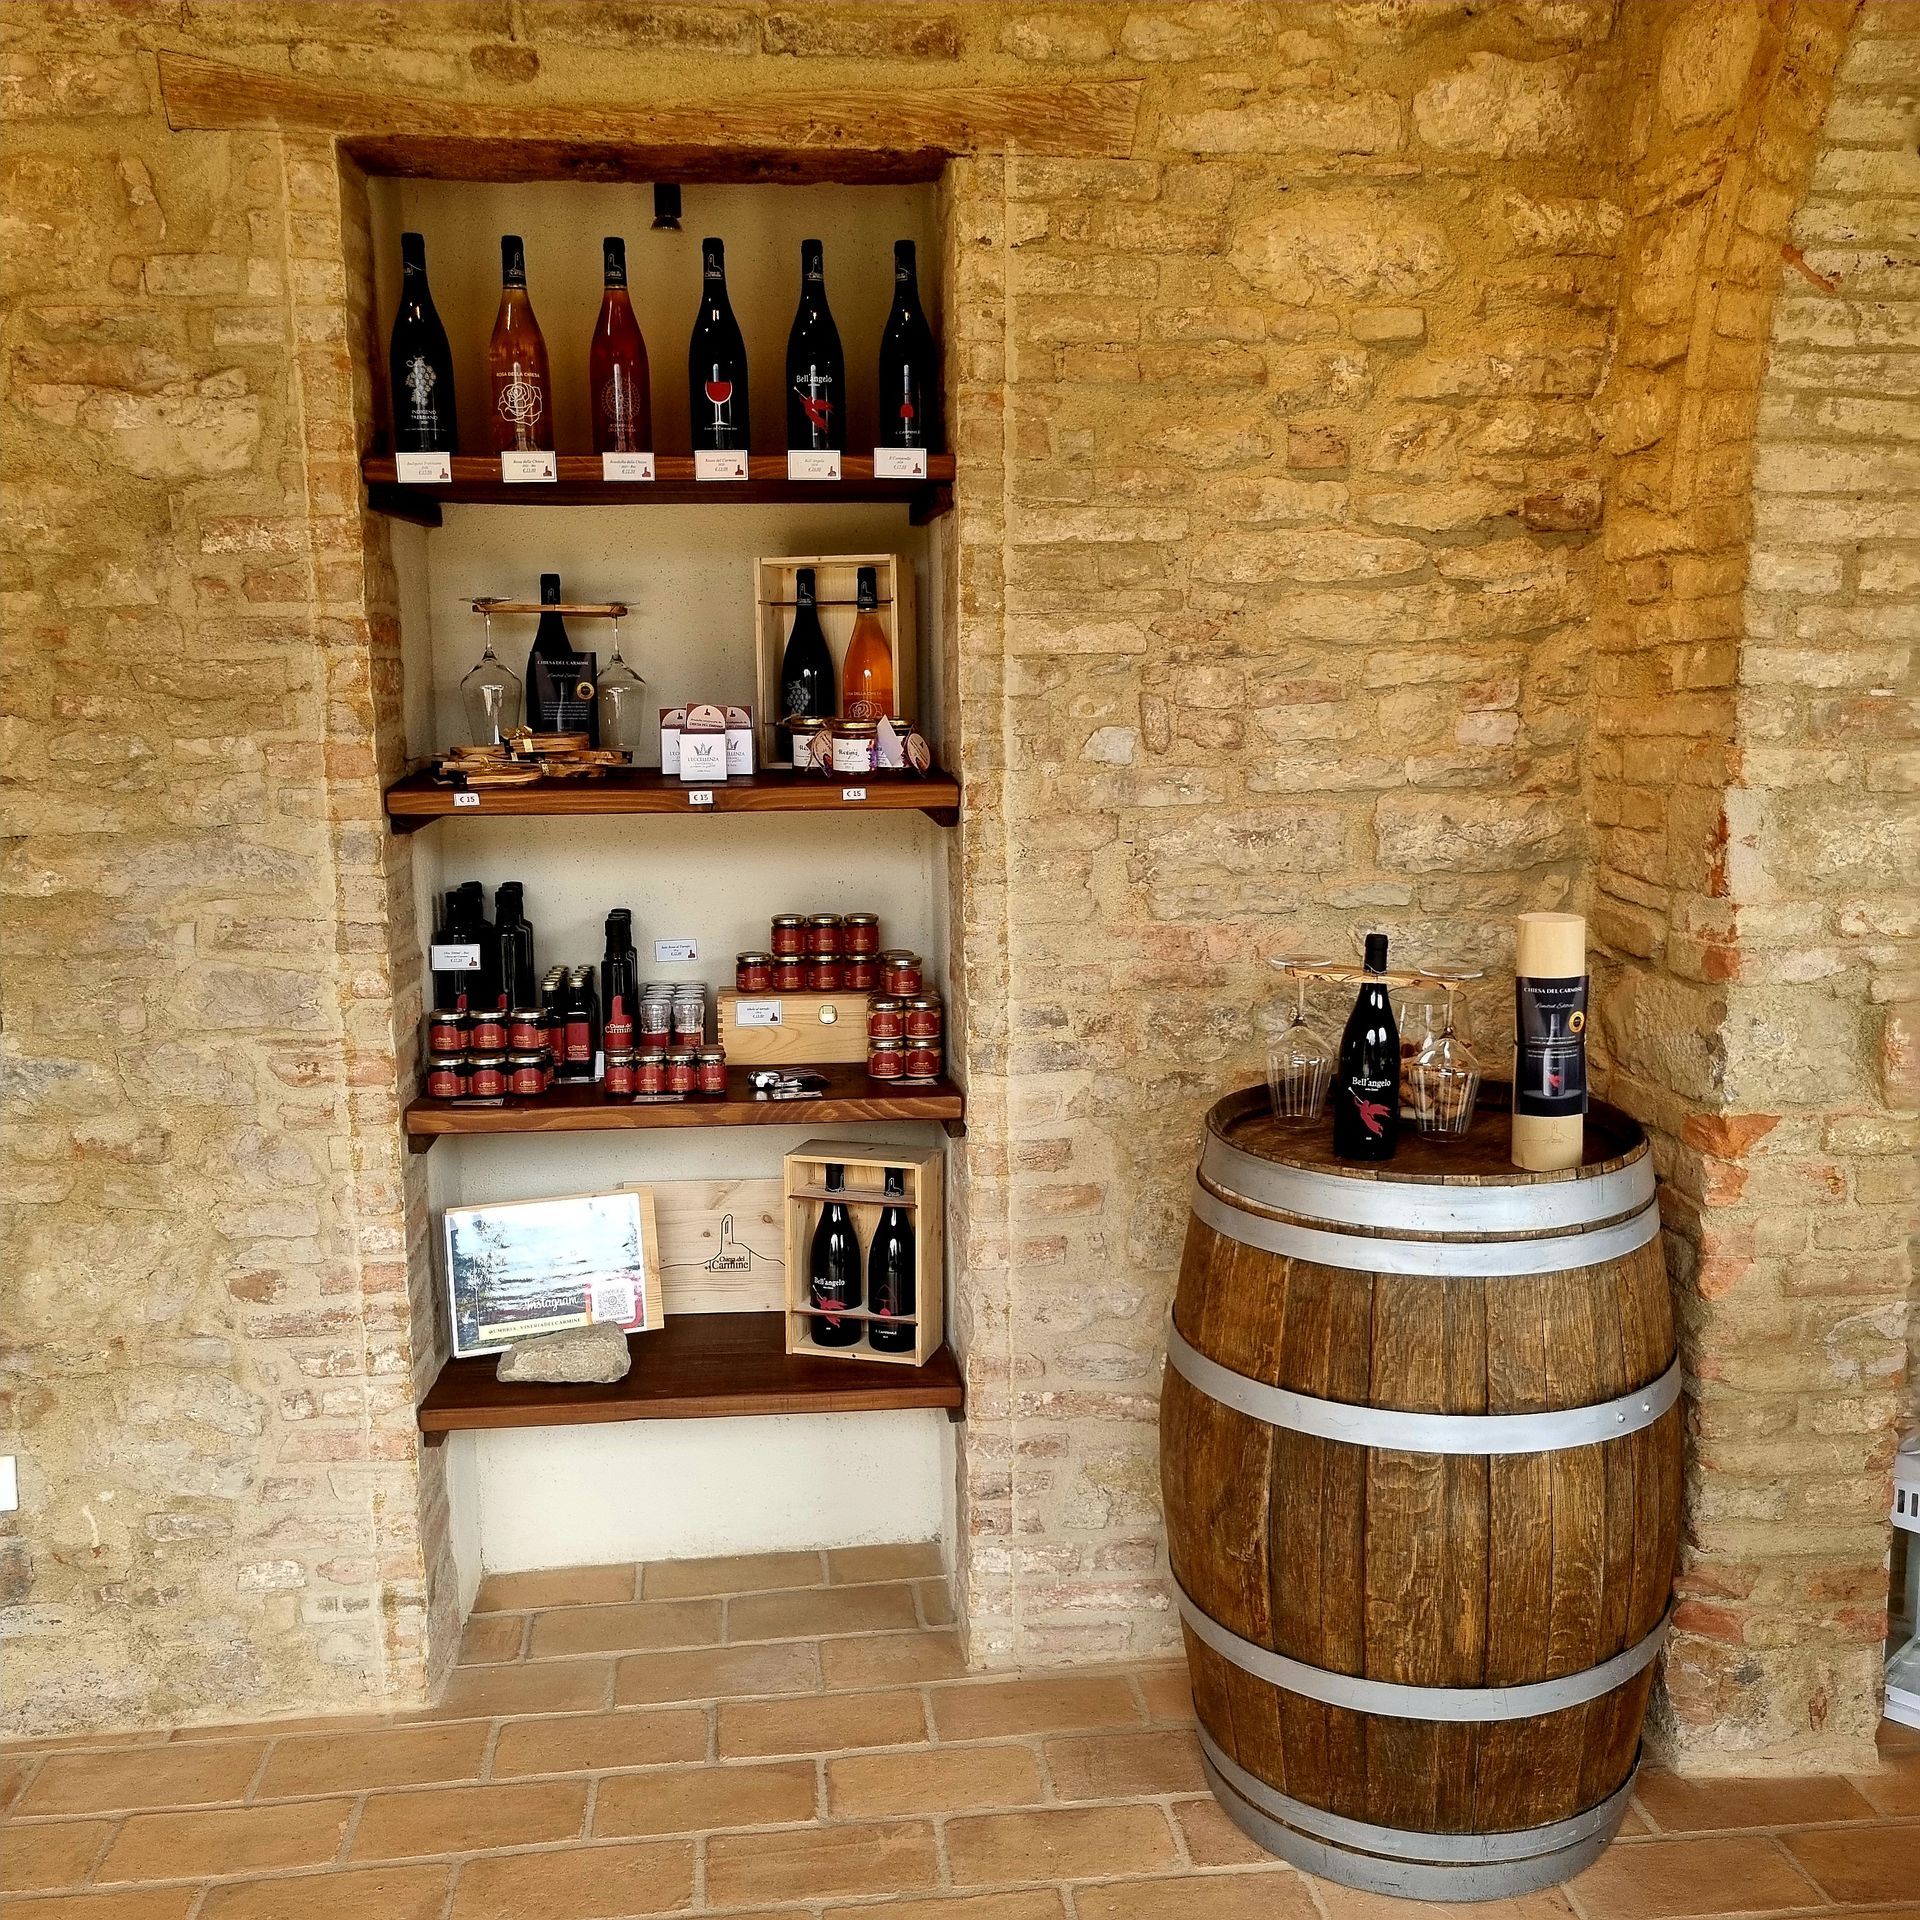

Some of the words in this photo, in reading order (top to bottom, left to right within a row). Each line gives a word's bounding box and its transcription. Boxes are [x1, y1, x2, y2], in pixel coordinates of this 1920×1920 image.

[796, 373, 833, 384] Bell'angelo
[1352, 1076, 1391, 1089] Bell'angelo
[711, 1260, 749, 1270] Carmine
[814, 1276, 846, 1287] Bell'angelo
